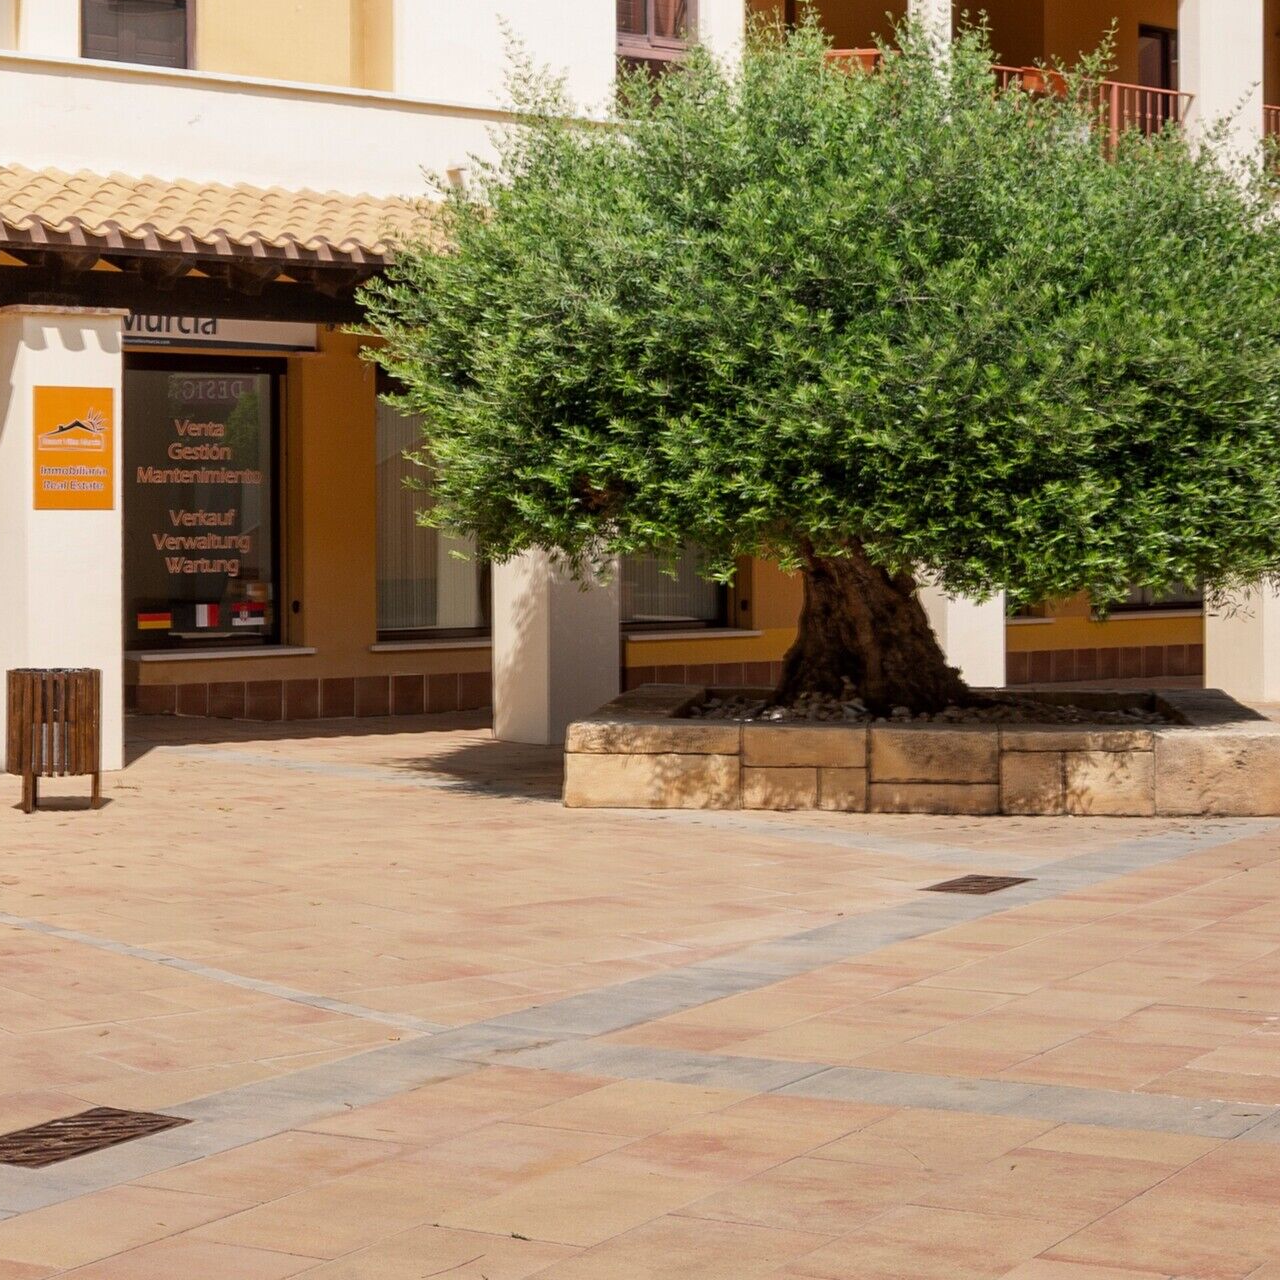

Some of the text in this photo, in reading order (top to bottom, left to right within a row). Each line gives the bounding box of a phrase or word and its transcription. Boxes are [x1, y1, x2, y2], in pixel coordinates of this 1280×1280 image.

[174, 419, 225, 437] Venta
[167, 442, 232, 460] Gestión
[136, 466, 262, 484] Mantenimiento
[44, 480, 104, 491] Real Estate
[169, 508, 236, 527] Verkauf
[152, 533, 251, 554] Verwaltung
[165, 556, 240, 577] Wartung
